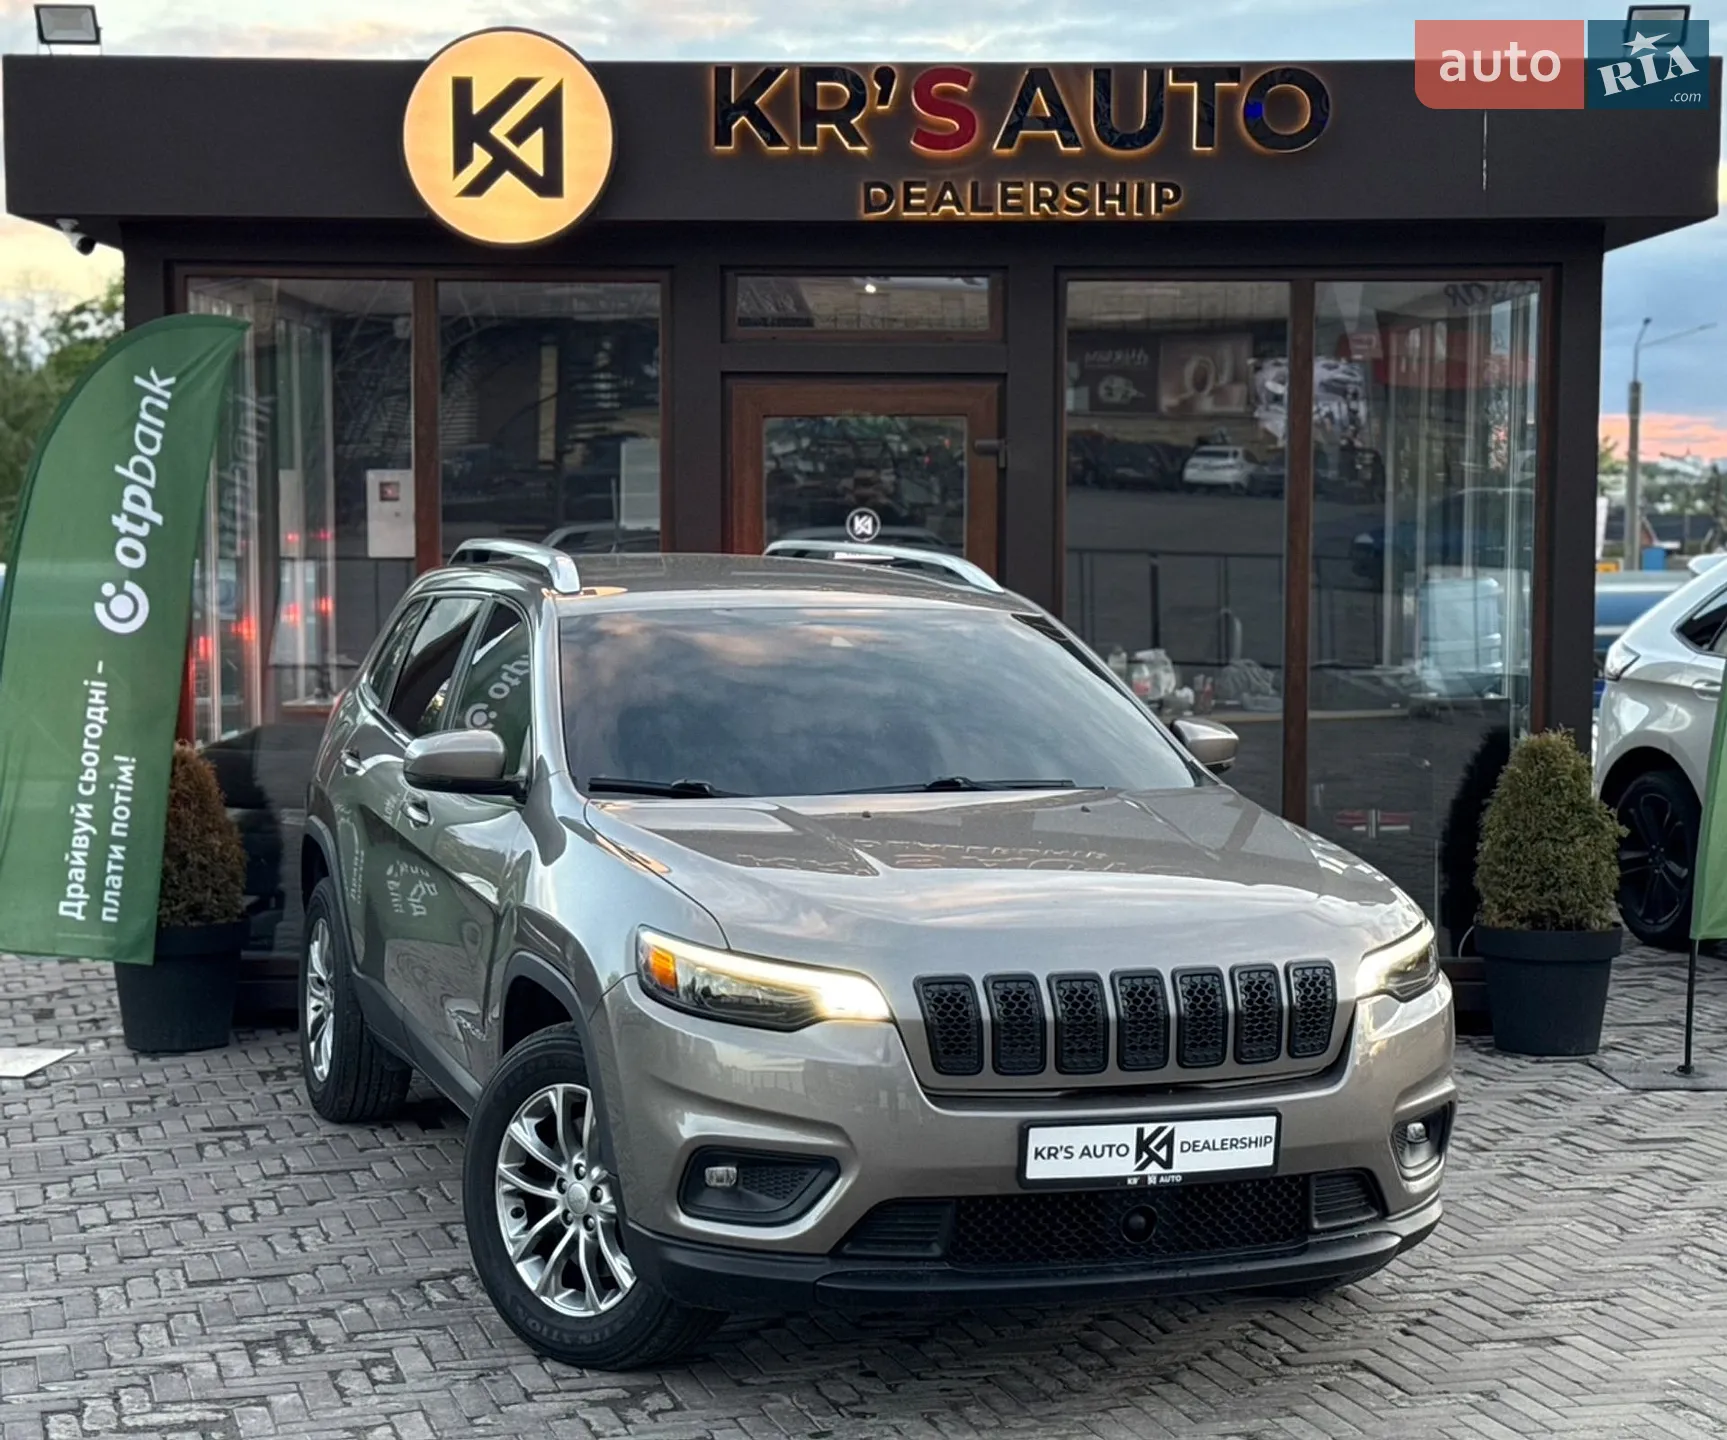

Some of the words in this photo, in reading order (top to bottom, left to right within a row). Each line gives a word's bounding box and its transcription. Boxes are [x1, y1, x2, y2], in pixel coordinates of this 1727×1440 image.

[713, 65, 978, 153] KR'S
[992, 65, 1331, 153] AUTO
[862, 180, 1183, 216] DEALERSHIP
[112, 366, 177, 569] otpbank
[77, 679, 109, 796] сьогодні
[109, 755, 137, 837] потім!
[58, 803, 97, 921] Драйвуй
[101, 844, 127, 923] плати
[1033, 1145, 1075, 1160] KR'S
[1079, 1143, 1130, 1159] AUTO
[1180, 1135, 1273, 1154] DEALERSHIP
[1159, 1174, 1183, 1184] AUTO
